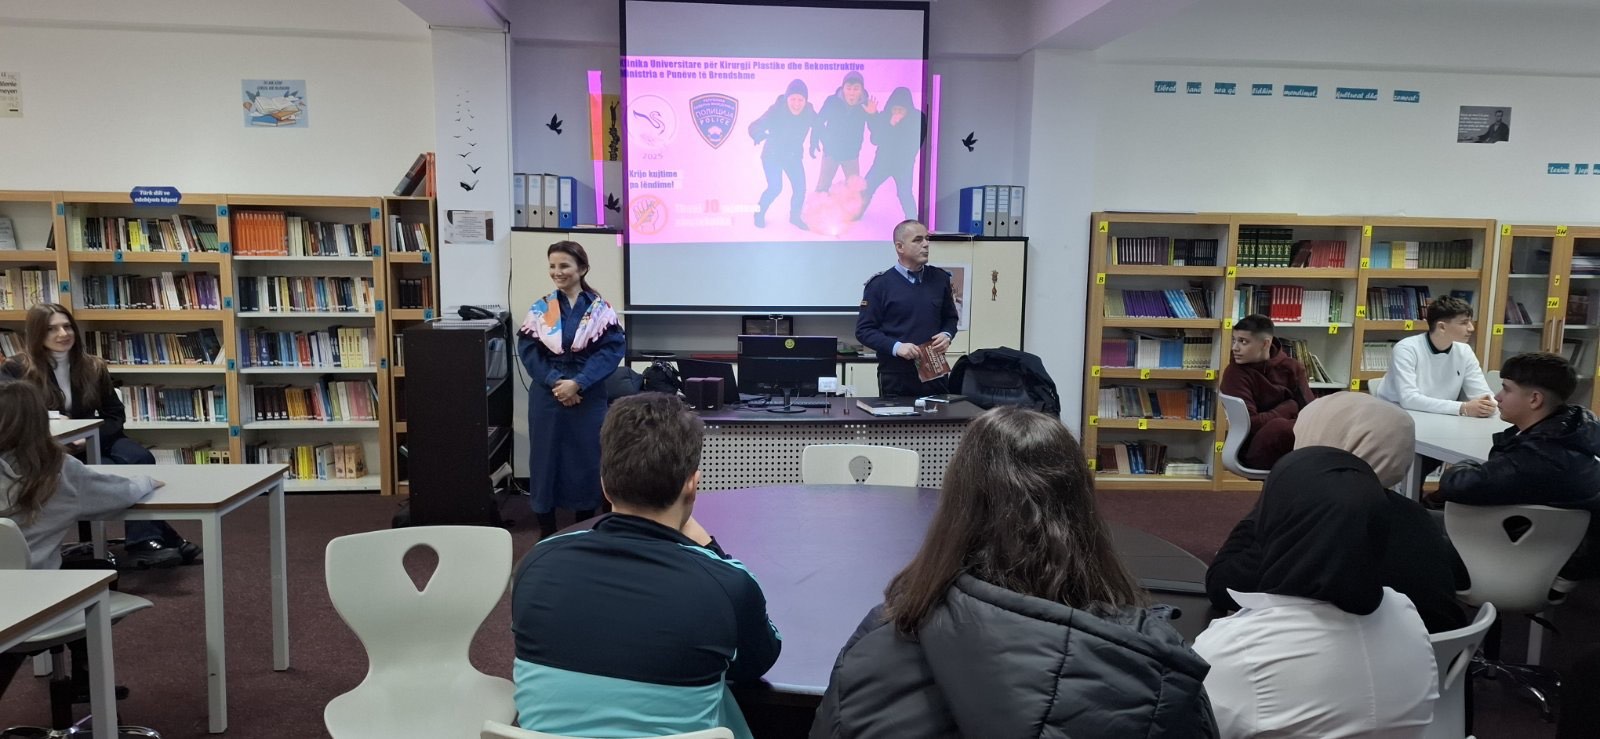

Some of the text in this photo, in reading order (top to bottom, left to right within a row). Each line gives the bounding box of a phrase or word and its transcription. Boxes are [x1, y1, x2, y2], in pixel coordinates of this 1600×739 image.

[650, 60, 702, 69] Universitare
[704, 60, 718, 70] për
[720, 60, 751, 71] Kirurgji
[753, 61, 786, 70] Plastike
[787, 61, 802, 70] dhe
[699, 70, 707, 79] të
[708, 71, 756, 80] Brendshme
[700, 117, 730, 126] POLICE
[648, 169, 678, 179] kujtime
[629, 182, 639, 190] pa
